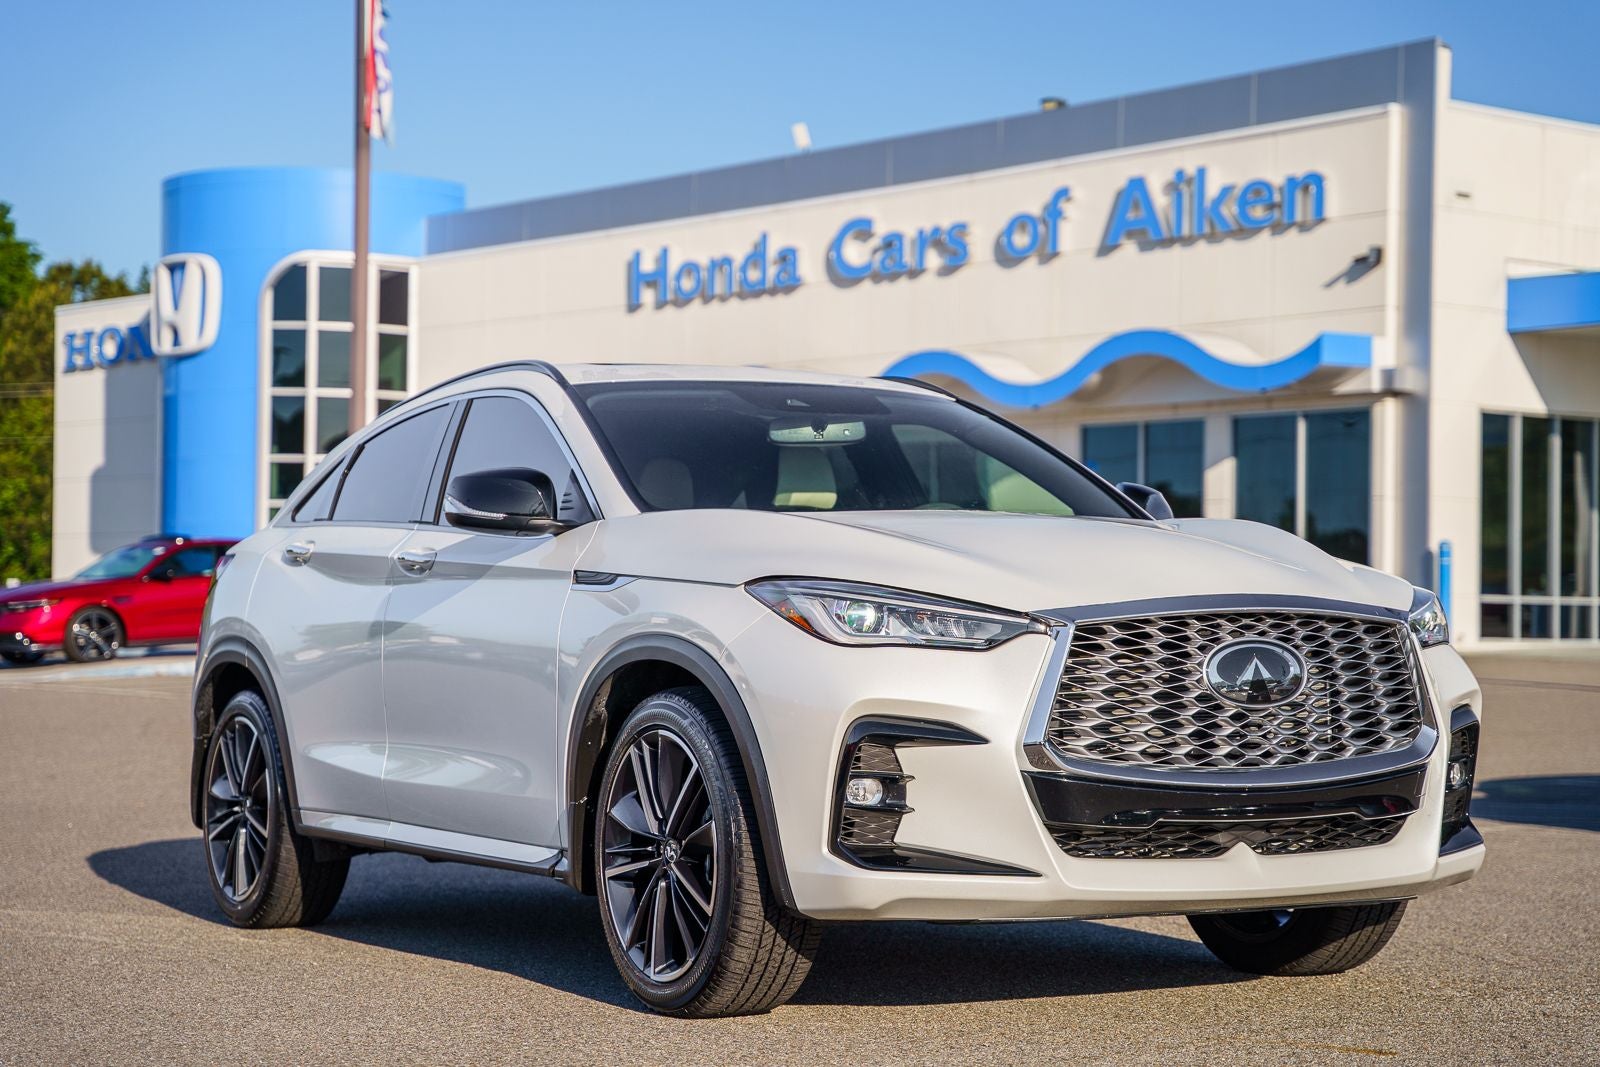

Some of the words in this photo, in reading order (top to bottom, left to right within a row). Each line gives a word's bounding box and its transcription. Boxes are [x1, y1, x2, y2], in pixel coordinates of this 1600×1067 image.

[629, 233, 801, 306] Honda
[829, 217, 969, 281] Cars
[1000, 186, 1069, 259] of
[1104, 167, 1325, 248] Aiken
